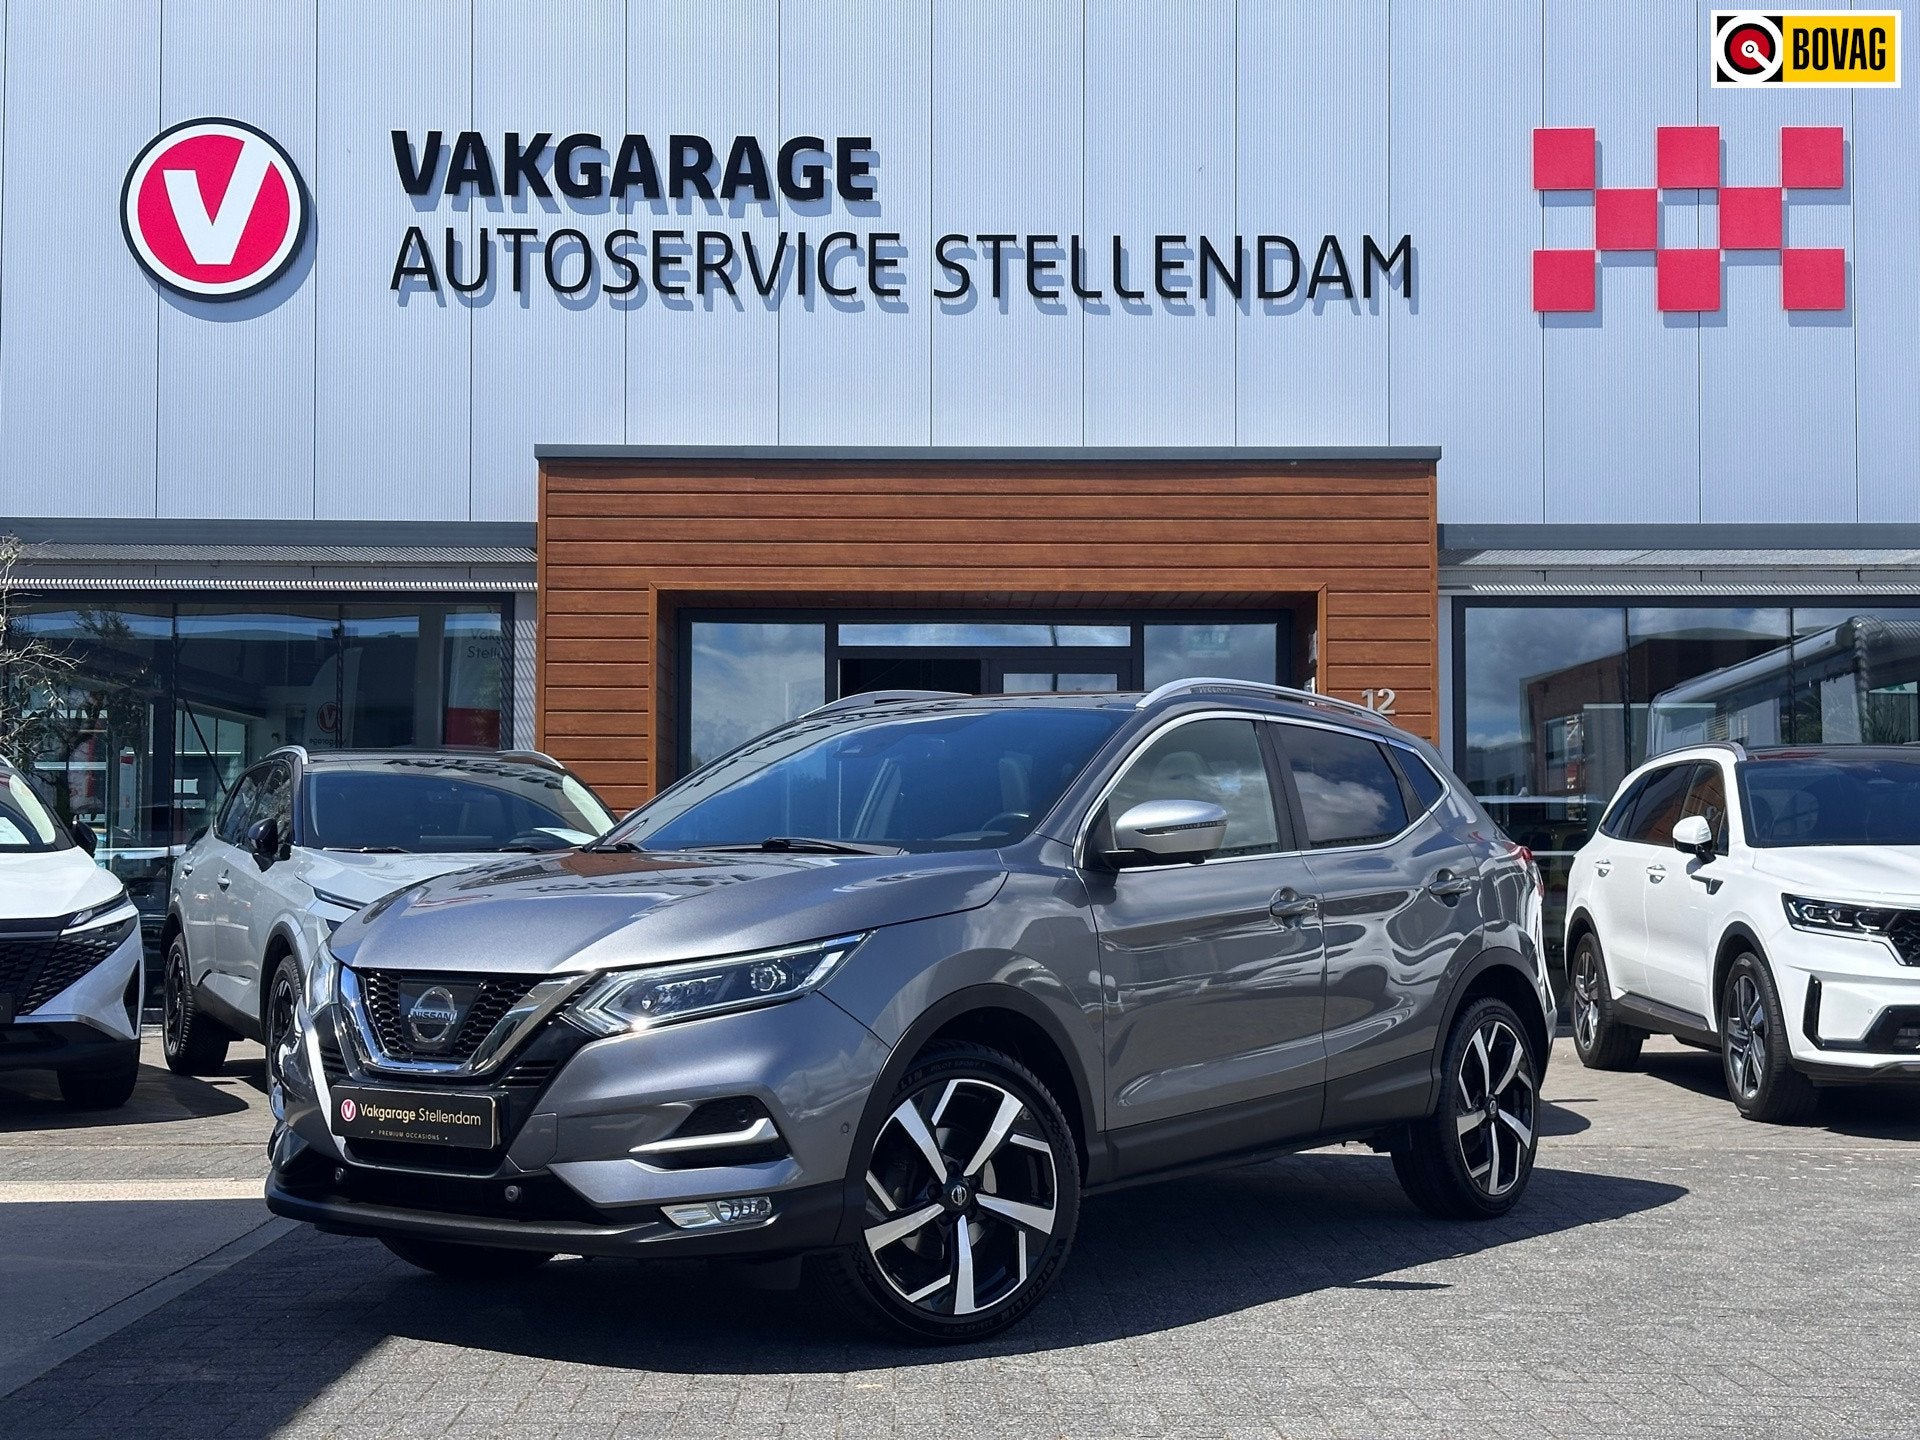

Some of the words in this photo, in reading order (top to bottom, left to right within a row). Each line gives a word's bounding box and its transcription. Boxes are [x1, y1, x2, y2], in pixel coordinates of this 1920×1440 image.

[391, 130, 875, 202] VAKGARAGE
[162, 138, 273, 266] V
[390, 226, 902, 297] AUTOSERVICE
[934, 234, 1413, 299] STELLENDAM
[1361, 688, 1396, 715] 12
[410, 1009, 456, 1022] NISSAN
[359, 1103, 416, 1124] Vakgarage
[418, 1108, 481, 1126] Stellendam
[378, 1129, 404, 1138] PREMIUM
[405, 1132, 440, 1141] OCCASIONS
